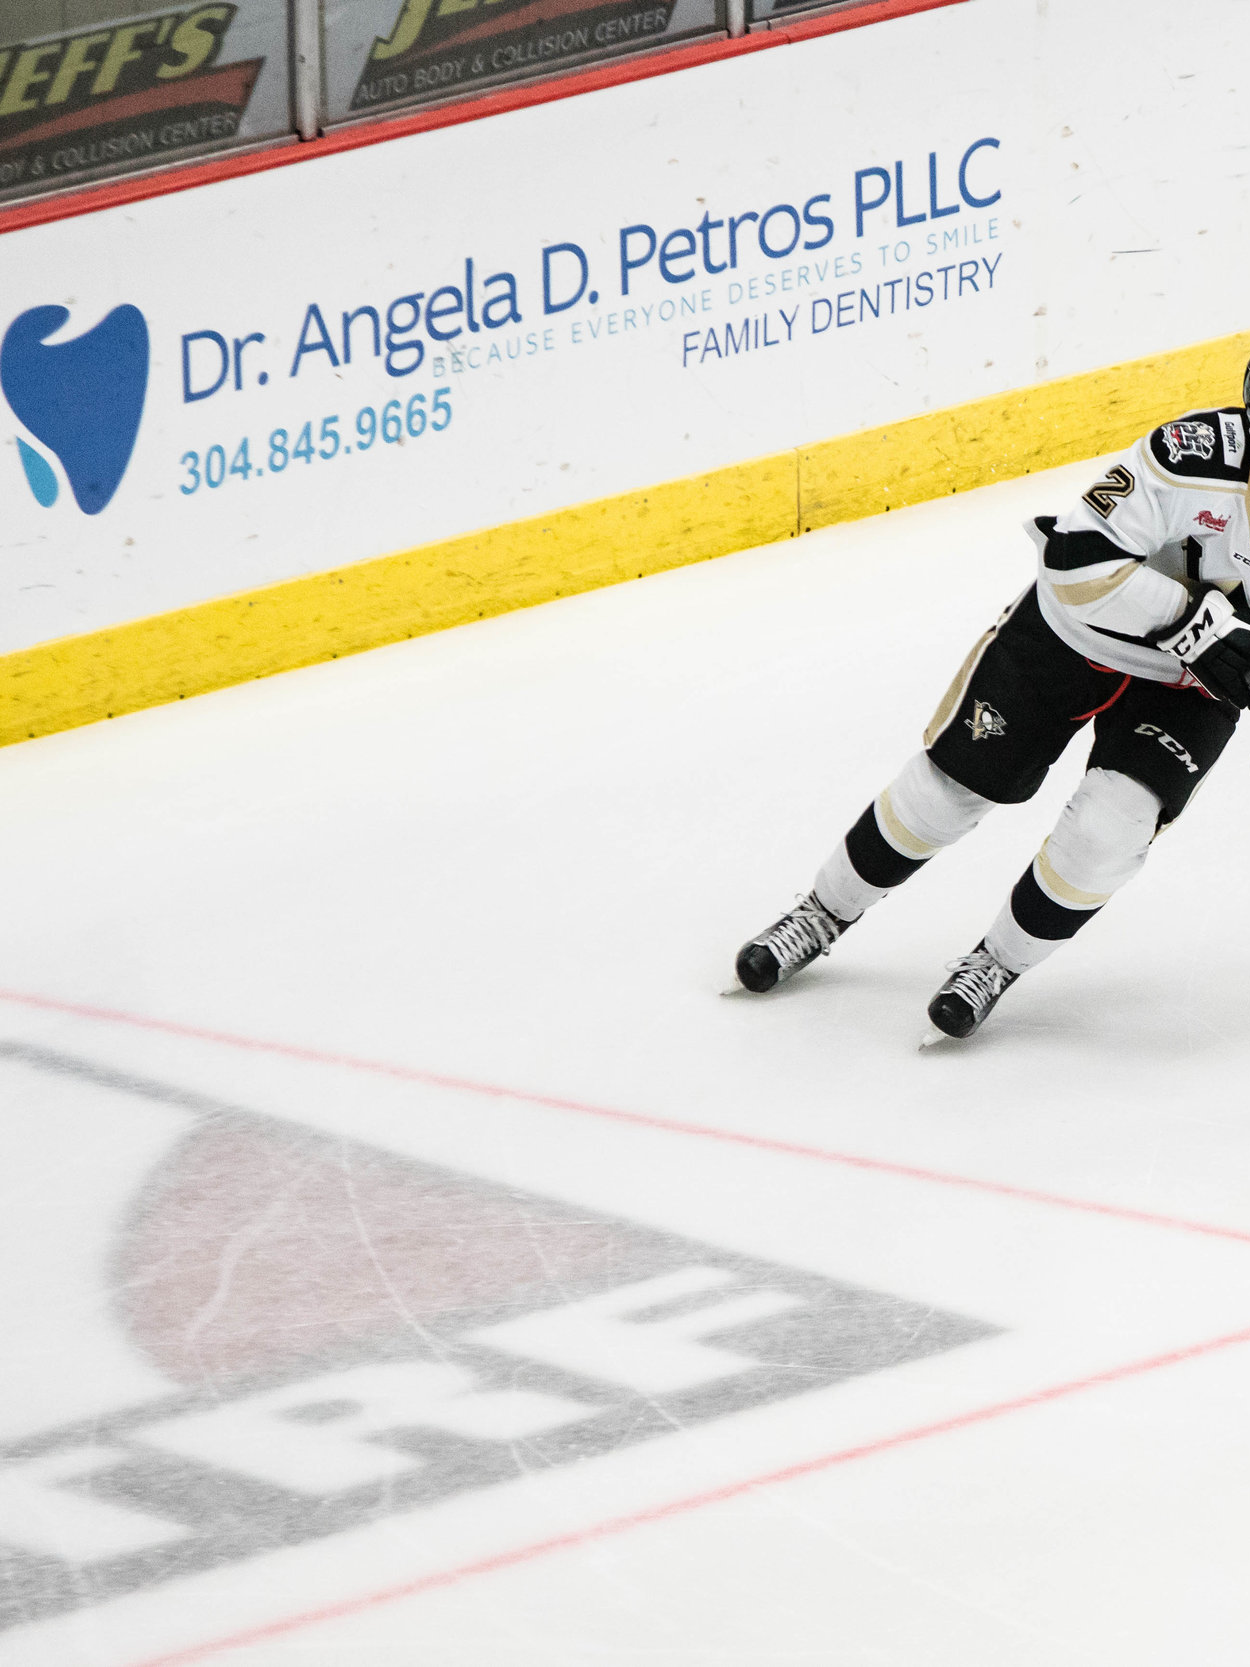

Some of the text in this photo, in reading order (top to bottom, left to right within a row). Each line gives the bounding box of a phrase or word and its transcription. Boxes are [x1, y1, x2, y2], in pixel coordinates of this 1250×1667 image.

[0, 7, 231, 116] EFF'S
[356, 7, 668, 100] AUTO BODY & COLLISION CENTER
[53, 128, 154, 170] COLLISION
[160, 111, 238, 144] CENTER
[180, 136, 1002, 403] Dr. Angela D. Petros PLLC
[432, 218, 1000, 378] BECAUSE EVERYONE DESERVES TO SMILE
[812, 252, 1003, 335] DENTISTRY
[179, 386, 453, 496] 304.845.9665
[1081, 464, 1136, 520] 2
[1170, 607, 1214, 657] CM
[1134, 723, 1199, 773] CCM
